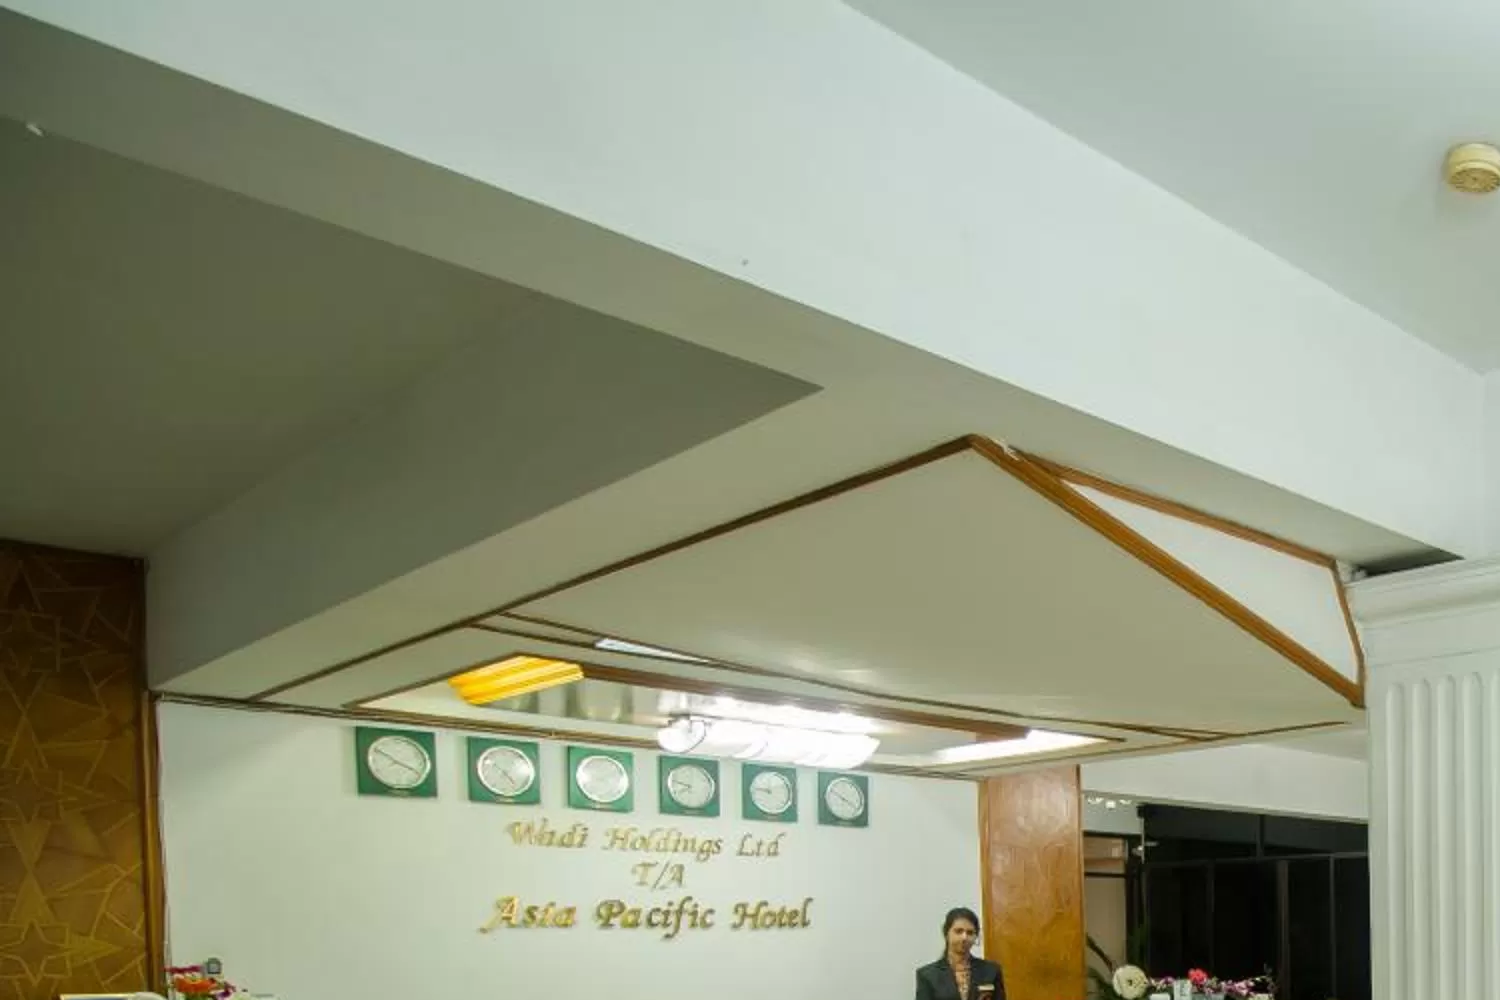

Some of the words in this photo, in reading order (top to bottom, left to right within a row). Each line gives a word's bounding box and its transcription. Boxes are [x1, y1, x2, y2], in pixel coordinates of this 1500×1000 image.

[601, 826, 724, 862] Holdings
[736, 832, 785, 857] Ltd
[632, 861, 685, 891] T/A
[480, 895, 577, 933] Asia
[593, 896, 715, 939] Pacific
[730, 897, 814, 930] Hotel
